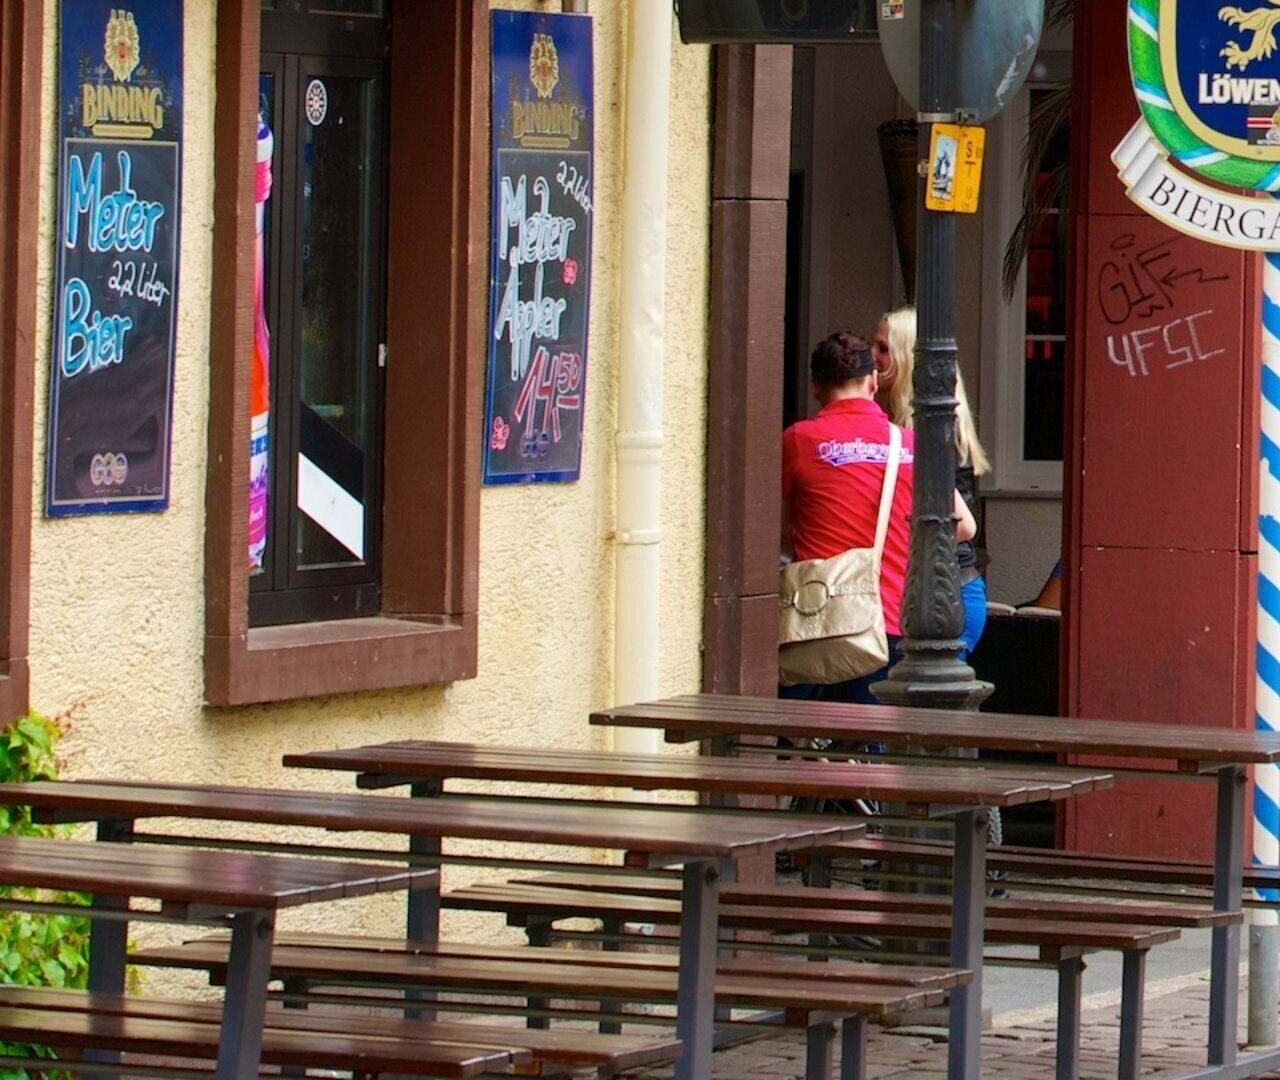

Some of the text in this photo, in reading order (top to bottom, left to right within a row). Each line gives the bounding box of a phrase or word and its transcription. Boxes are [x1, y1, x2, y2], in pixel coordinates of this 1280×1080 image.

[82, 83, 163, 129] BINDING
[512, 100, 579, 140] BINDING
[64, 150, 165, 253] Meter
[61, 277, 132, 378] Bier
